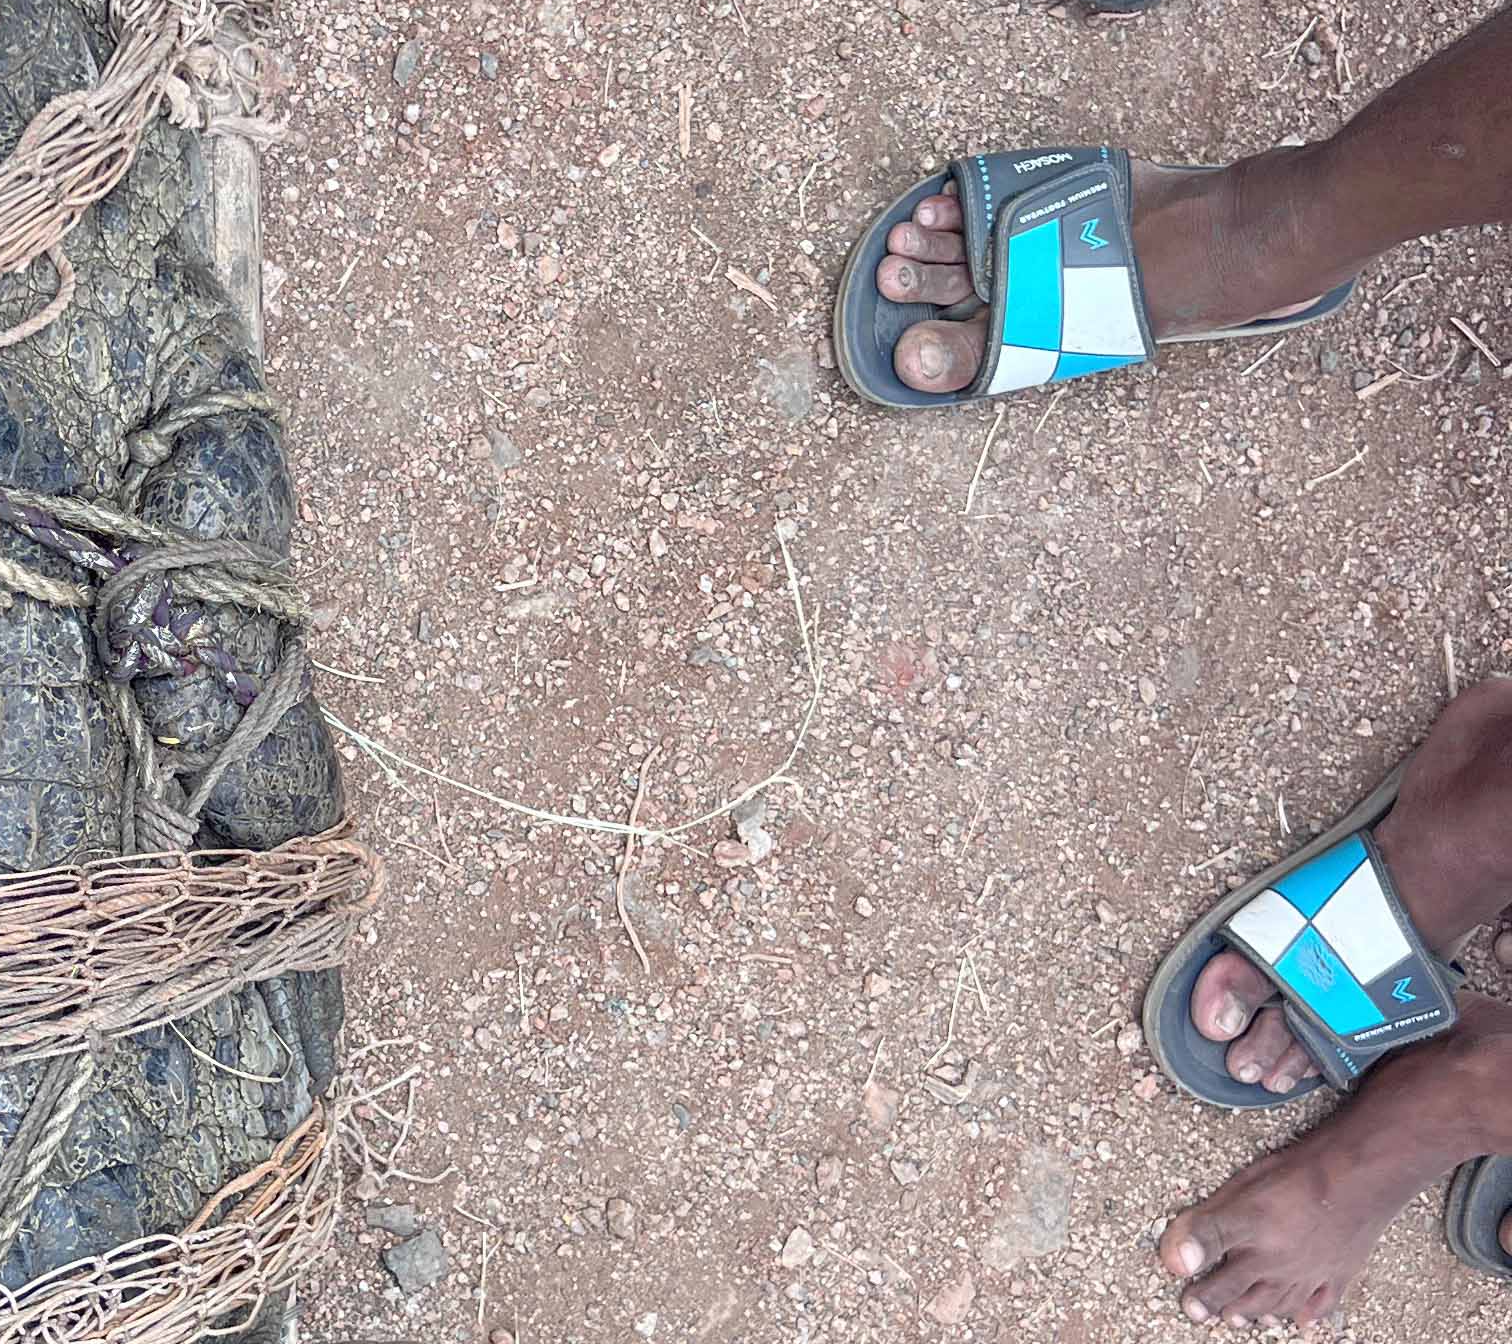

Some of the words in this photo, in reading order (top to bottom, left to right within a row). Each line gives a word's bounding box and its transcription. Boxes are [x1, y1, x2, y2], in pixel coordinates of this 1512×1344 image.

[1067, 181, 1108, 204] PREMIUM
[1019, 199, 1066, 224] FOOTWEAR
[1353, 1024, 1393, 1043] PREMIUM
